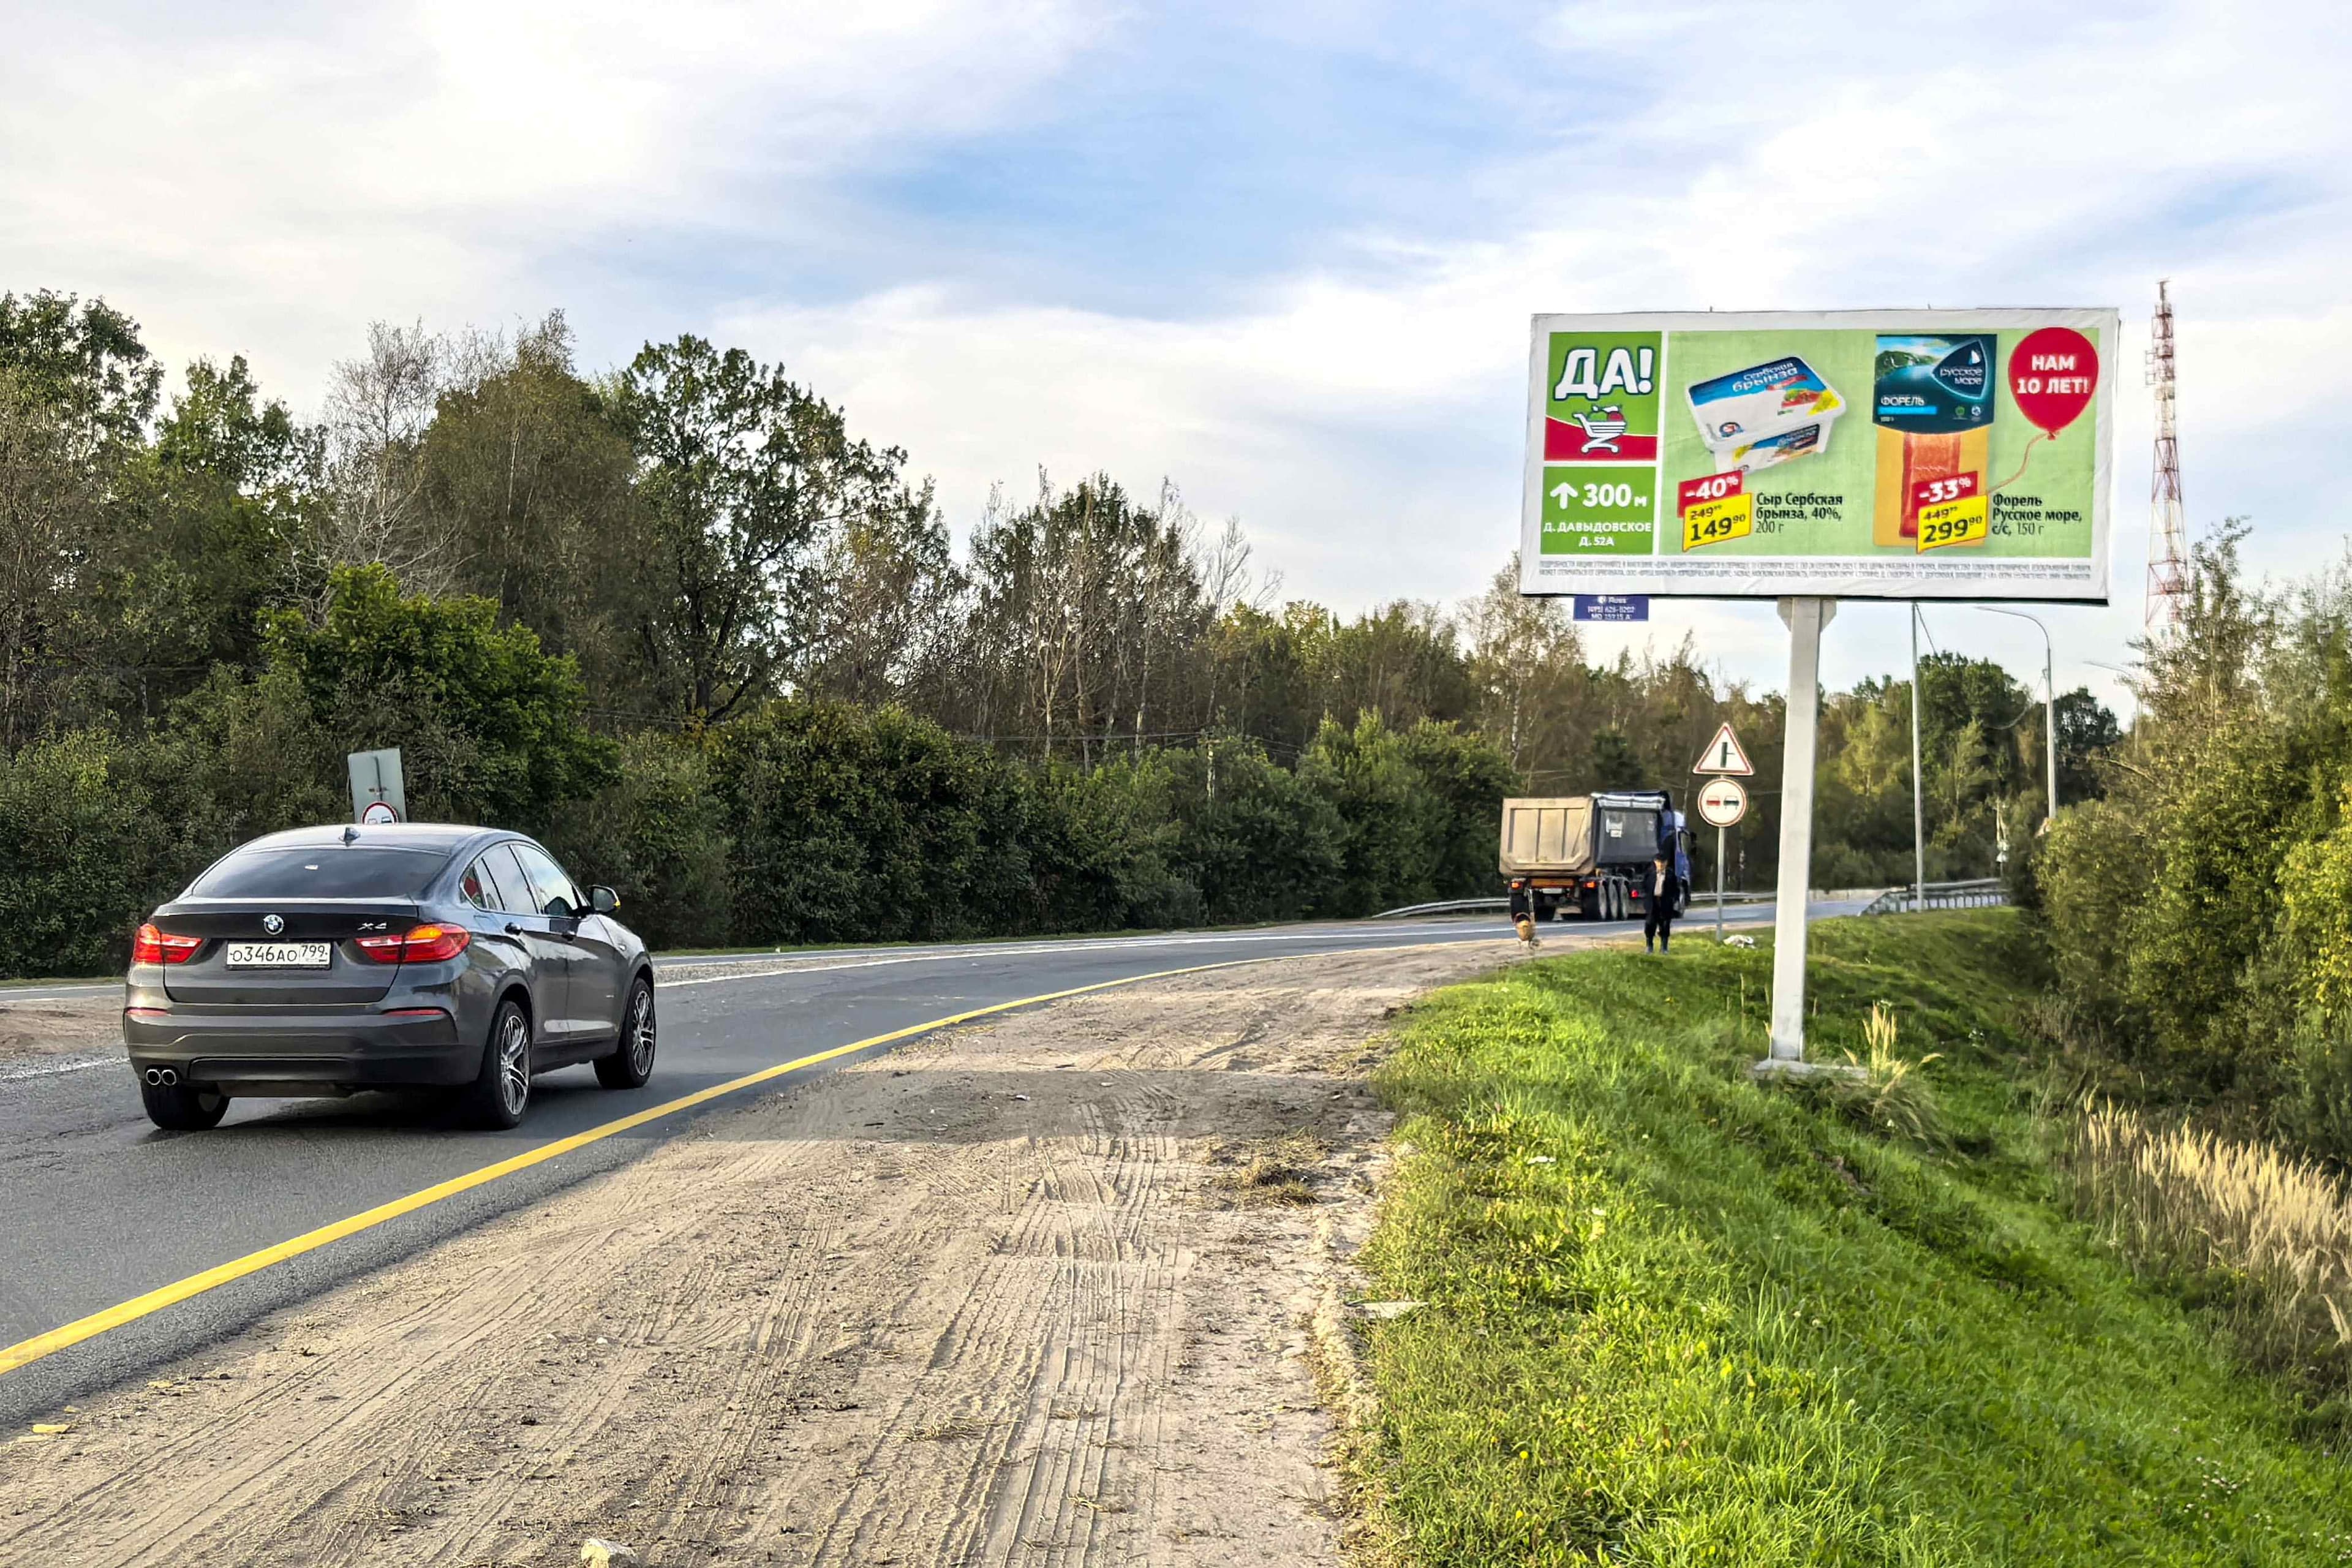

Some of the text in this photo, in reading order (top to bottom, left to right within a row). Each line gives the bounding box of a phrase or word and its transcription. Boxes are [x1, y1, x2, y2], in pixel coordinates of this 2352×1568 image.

[2032, 355, 2075, 371] НАМ
[1555, 349, 1653, 399] ДА!
[2017, 377, 2088, 394] 10 ЛЕТ!
[1583, 484, 1632, 507] 300
[1686, 476, 1738, 499] -40%
[1919, 477, 1972, 502] -33%
[1757, 492, 1843, 508] Сыр Сербская
[1993, 493, 2043, 510] Форель
[1756, 507, 1807, 522] брынза,
[1993, 508, 2082, 524] Русское море,
[1558, 522, 1651, 532] ДАВЫДОВСКОЕ
[1755, 521, 1775, 533] 200
[2018, 522, 2035, 535] 150
[301, 945, 326, 958] 799
